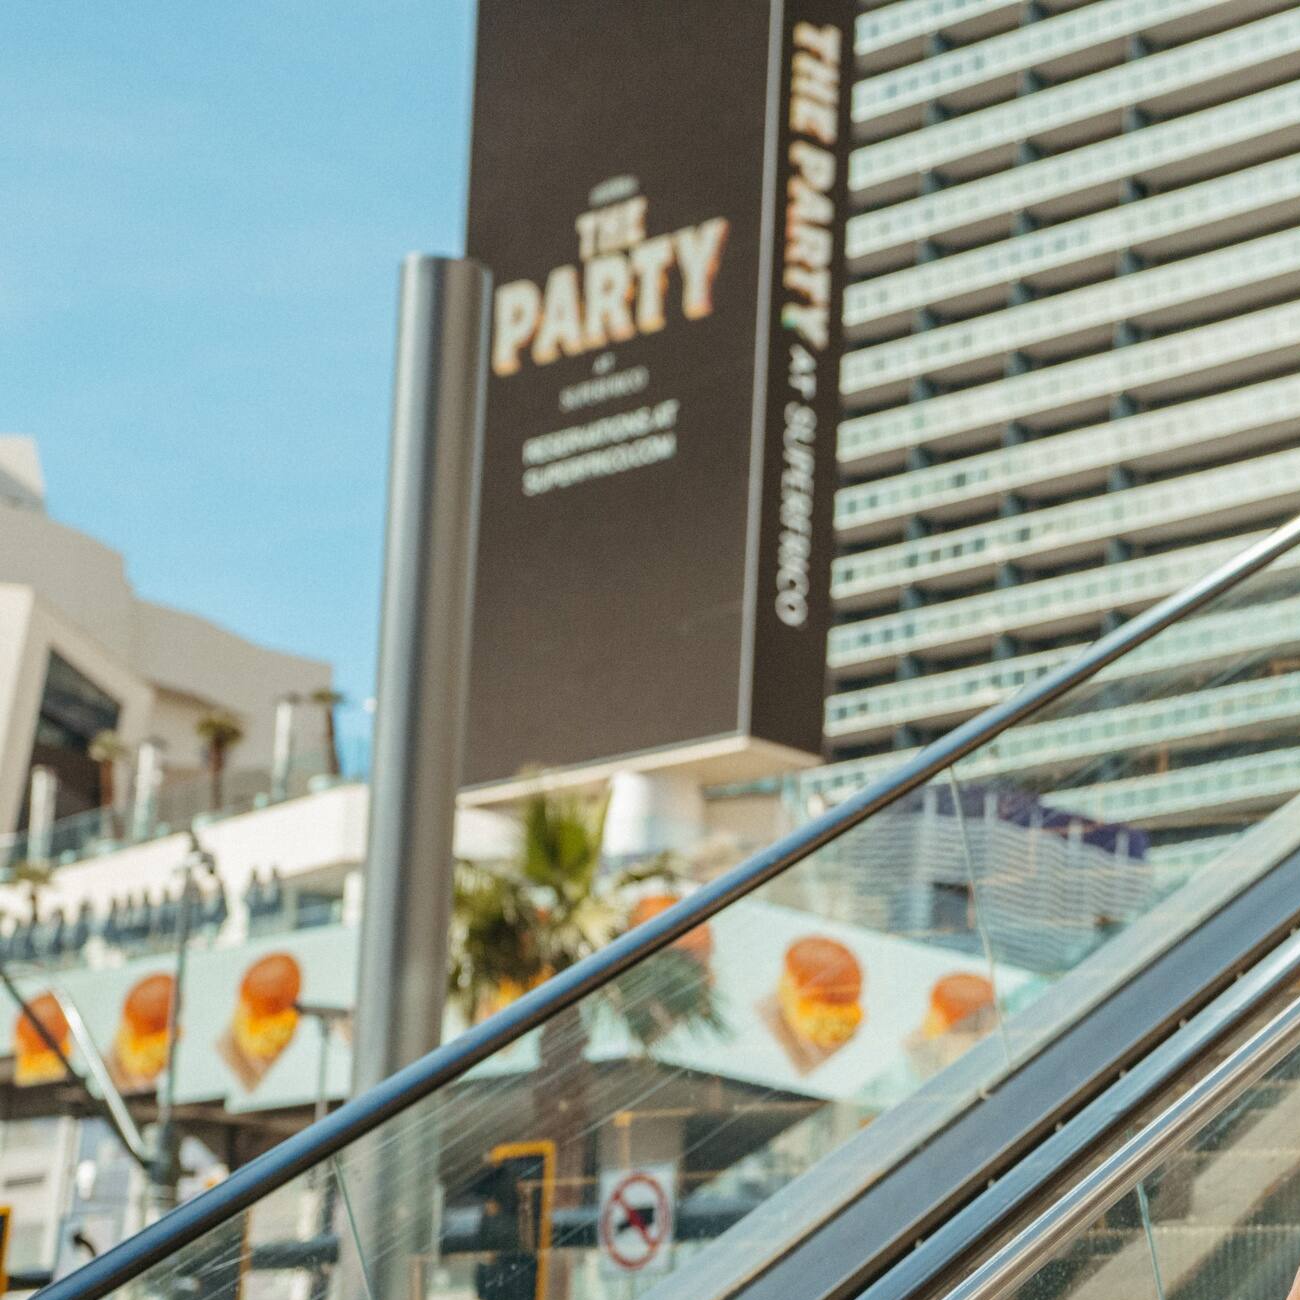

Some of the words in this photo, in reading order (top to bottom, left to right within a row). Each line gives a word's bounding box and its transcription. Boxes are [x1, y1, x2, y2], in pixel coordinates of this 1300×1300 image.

[789, 21, 842, 144] THE
[576, 197, 648, 262] THE
[781, 139, 837, 347] PARTY
[491, 216, 729, 377] PARTY
[788, 343, 817, 400] AT
